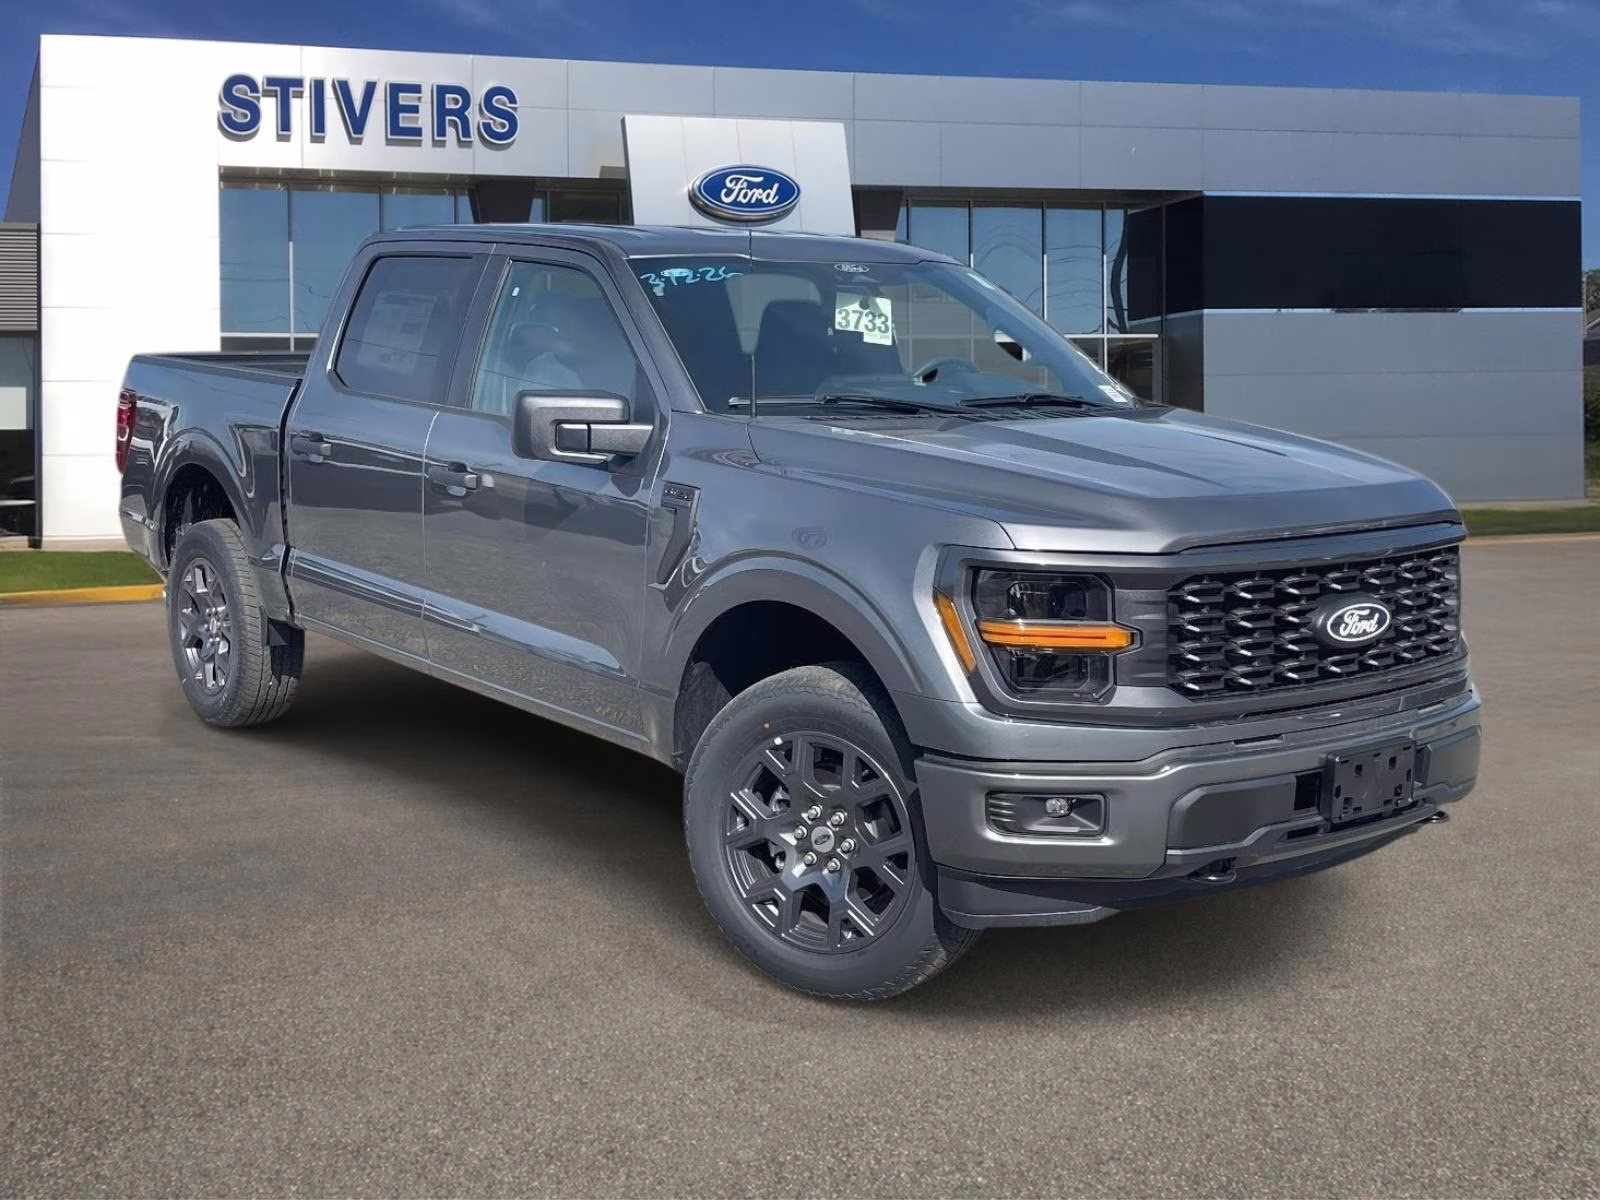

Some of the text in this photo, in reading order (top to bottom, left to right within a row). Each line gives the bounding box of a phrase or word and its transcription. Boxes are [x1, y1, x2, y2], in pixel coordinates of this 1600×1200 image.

[219, 74, 519, 145] STIVERS
[720, 174, 780, 204] Ford
[837, 308, 890, 334] 3733
[1339, 609, 1380, 636] Ford
